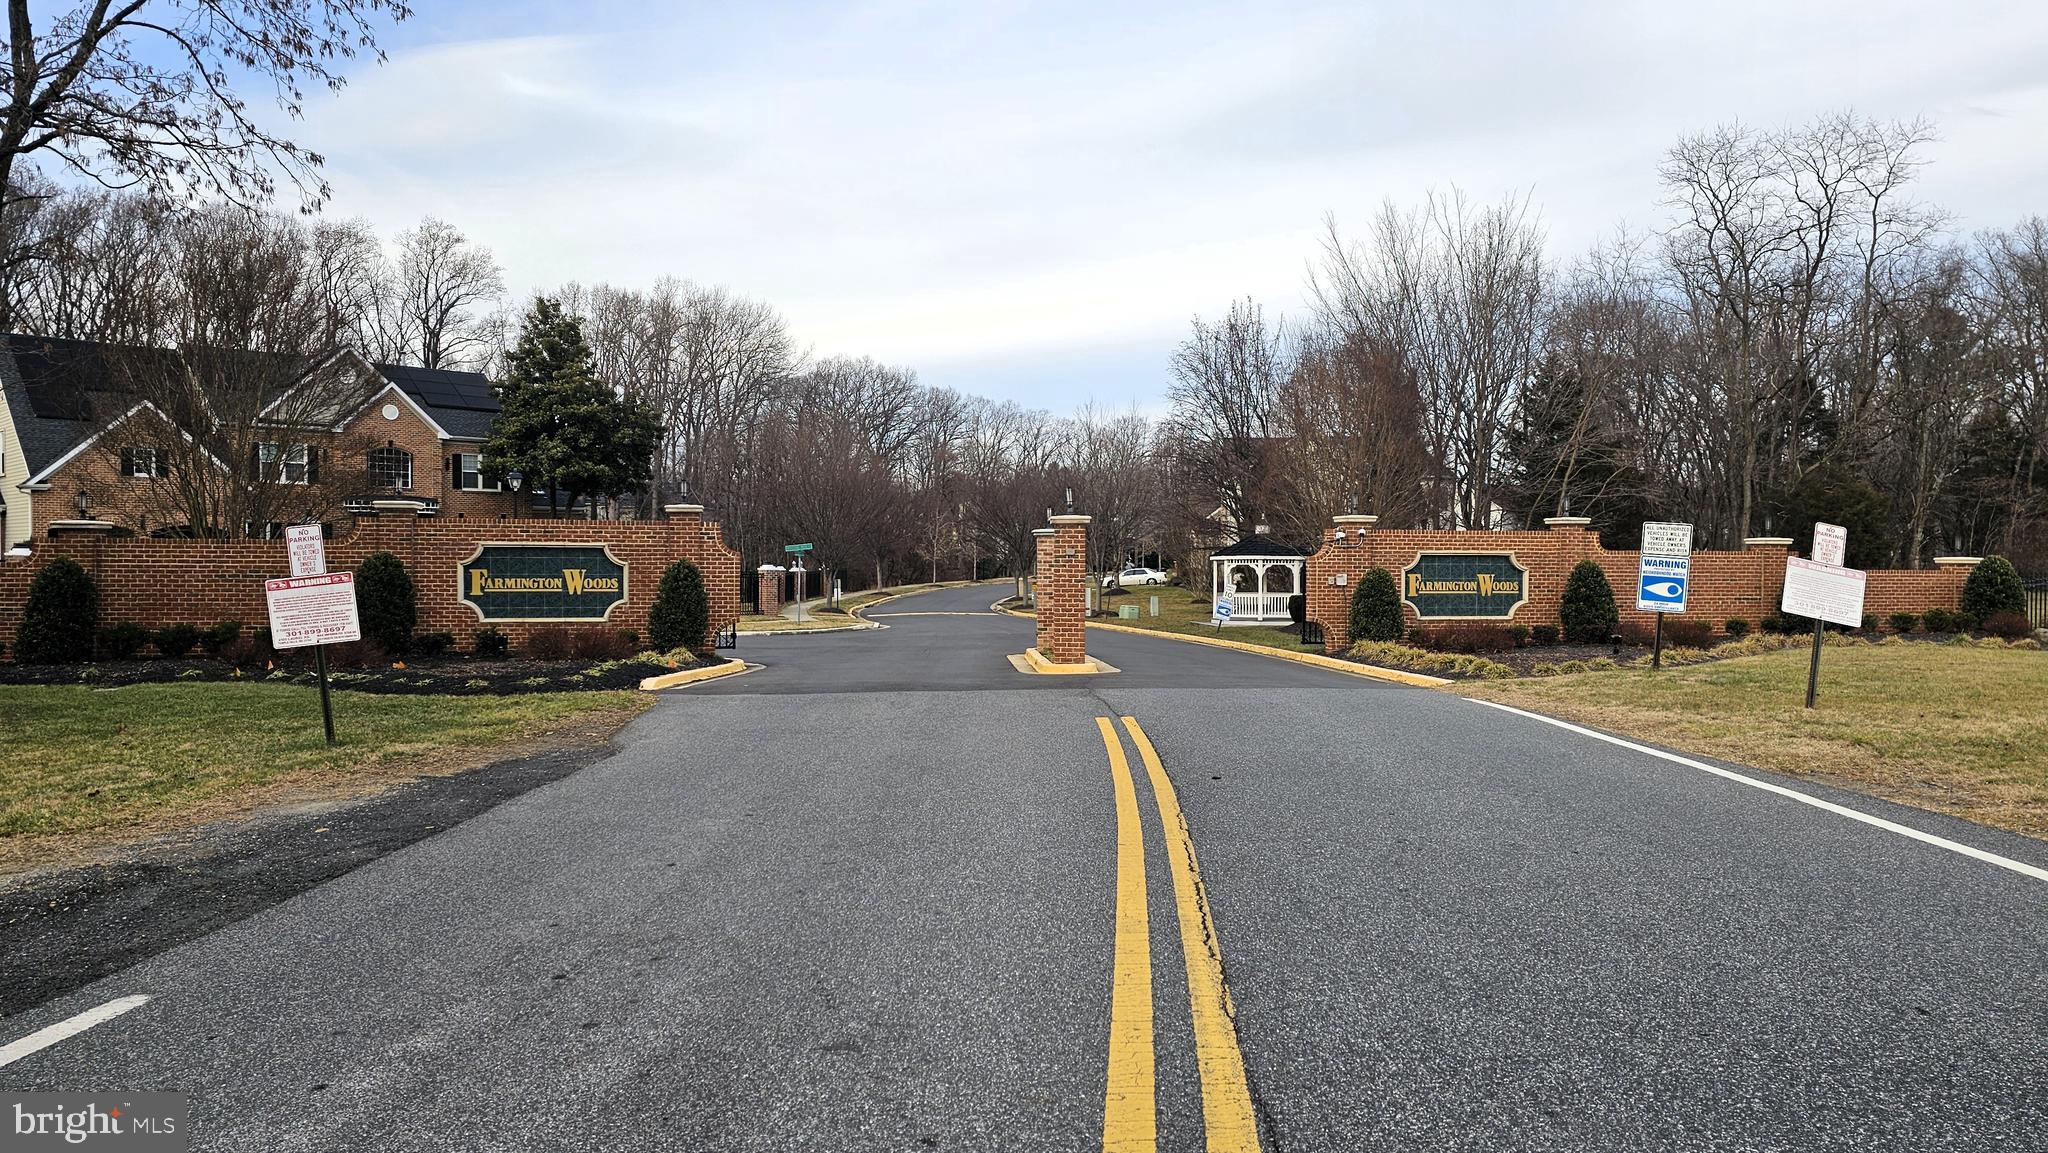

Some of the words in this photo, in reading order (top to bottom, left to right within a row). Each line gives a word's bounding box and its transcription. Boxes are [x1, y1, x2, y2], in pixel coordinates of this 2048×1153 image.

[289, 535, 320, 543] PARKING
[1817, 531, 1844, 540] PARKING
[1644, 559, 1687, 569] WARNING
[1807, 563, 1846, 576] WARNING
[289, 576, 332, 588] WARNING
[469, 569, 562, 596] FARMINGTON
[562, 569, 618, 595] WOODS
[1407, 573, 1477, 596] FARMINGTON
[1477, 573, 1519, 596] WOODS
